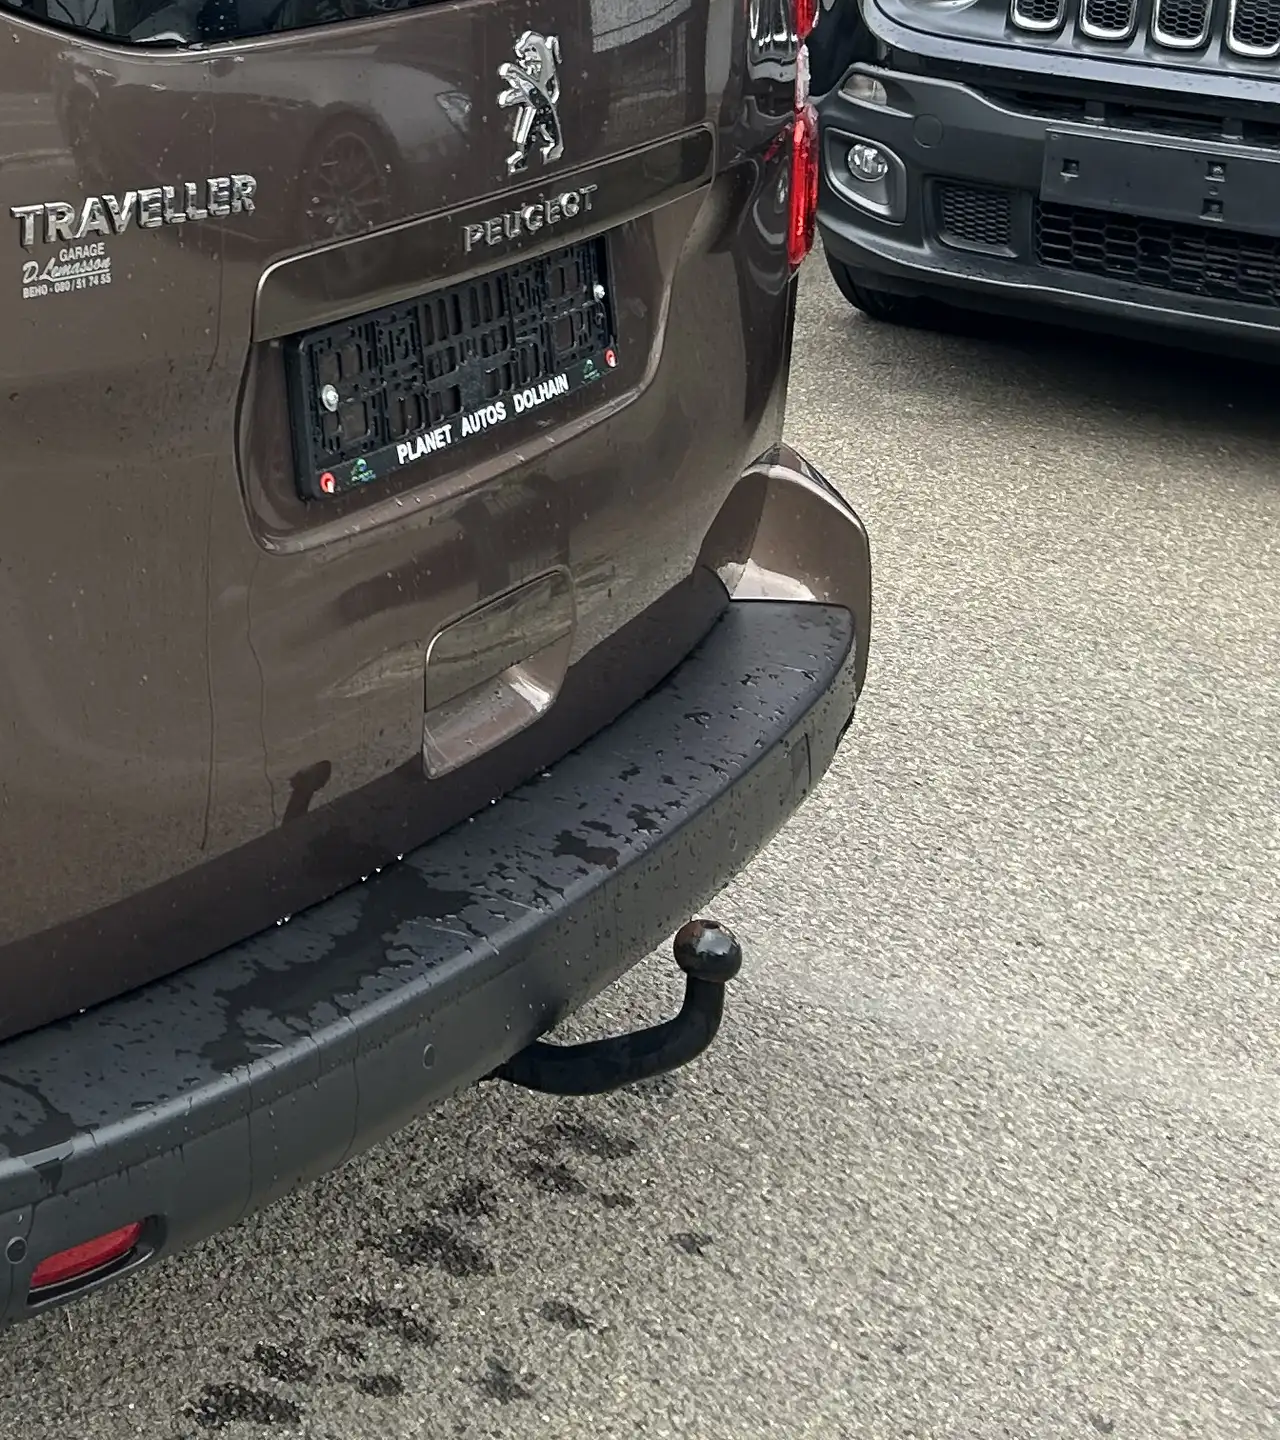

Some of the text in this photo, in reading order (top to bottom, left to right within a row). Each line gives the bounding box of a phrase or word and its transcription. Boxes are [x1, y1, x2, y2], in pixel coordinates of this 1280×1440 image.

[10, 174, 258, 247] TRAVELLER
[462, 183, 598, 252] PEUGEOT
[59, 242, 105, 262] GARAGE
[396, 373, 570, 465] PLANET AUTOS DOLHAIN
